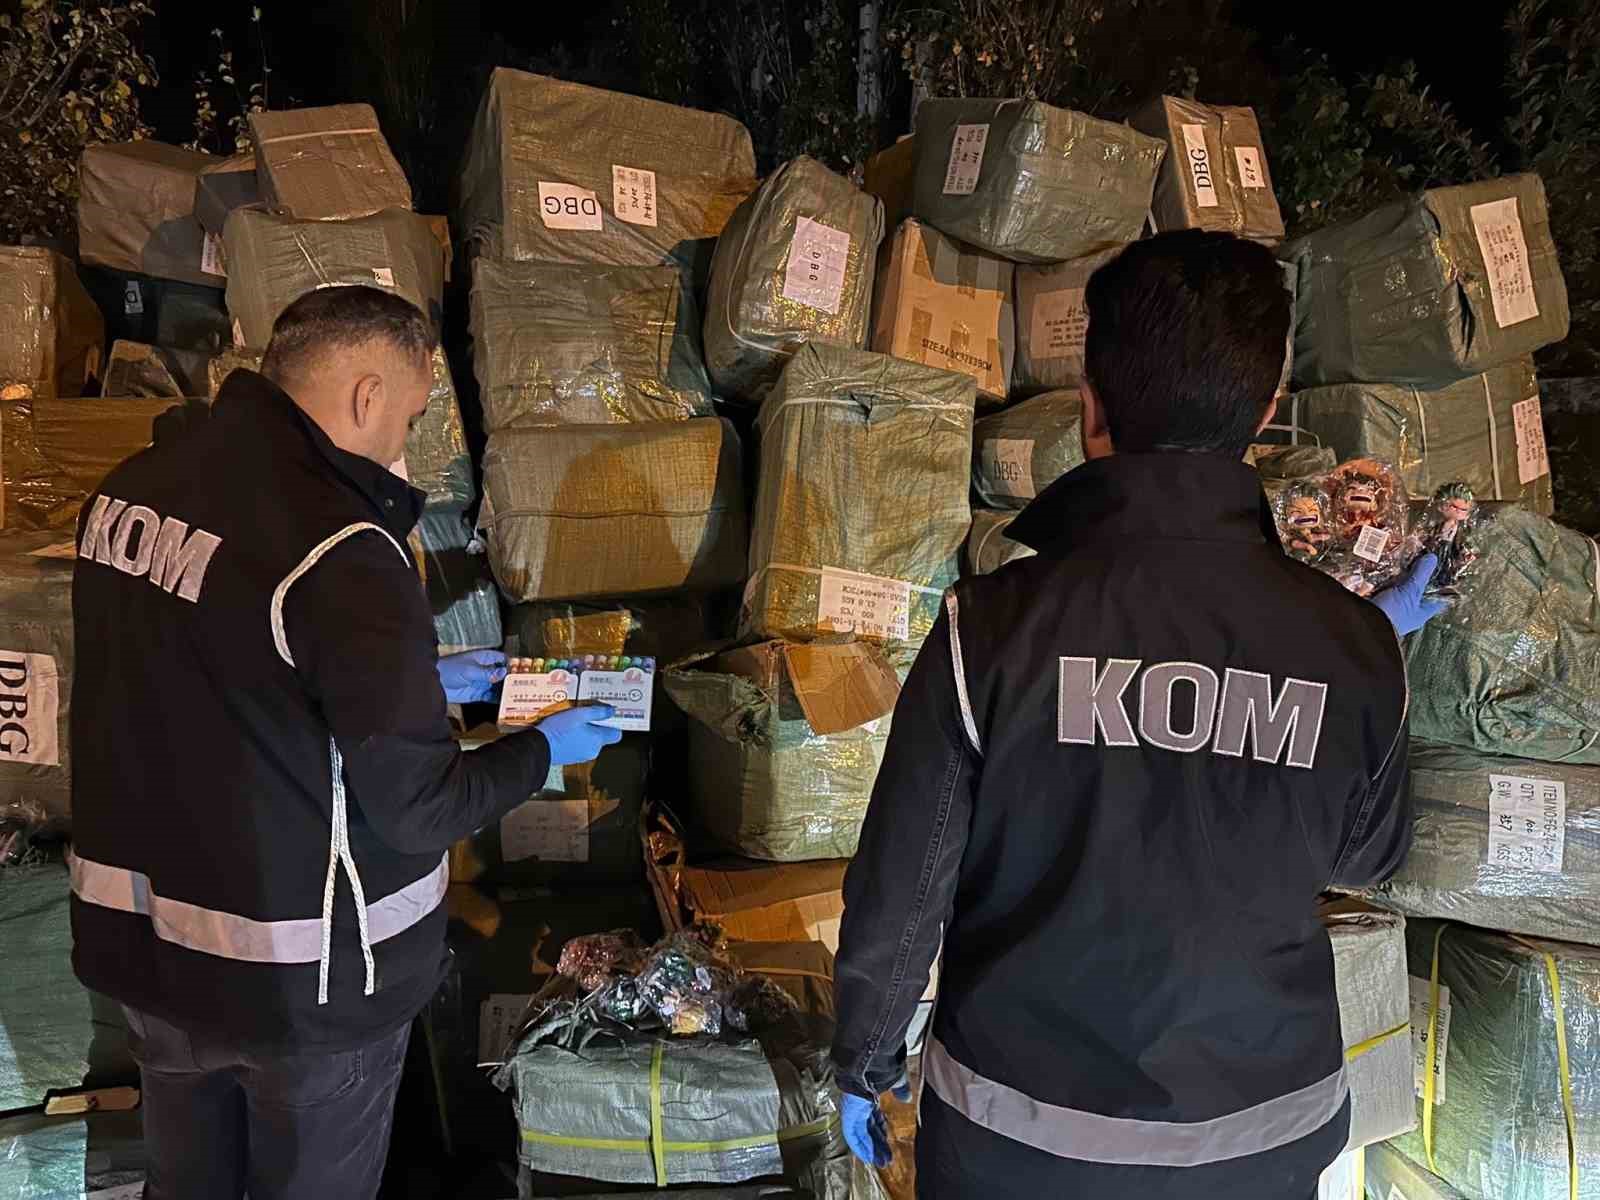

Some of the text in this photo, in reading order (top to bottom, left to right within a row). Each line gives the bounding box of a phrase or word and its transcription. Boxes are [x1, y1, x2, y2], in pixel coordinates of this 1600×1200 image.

[1190, 148, 1212, 188] DBG
[544, 196, 597, 216] DBG
[993, 460, 1019, 482] DBG
[80, 494, 223, 604] KOM
[0, 659, 30, 756] DBG
[1057, 656, 1328, 770] KOM
